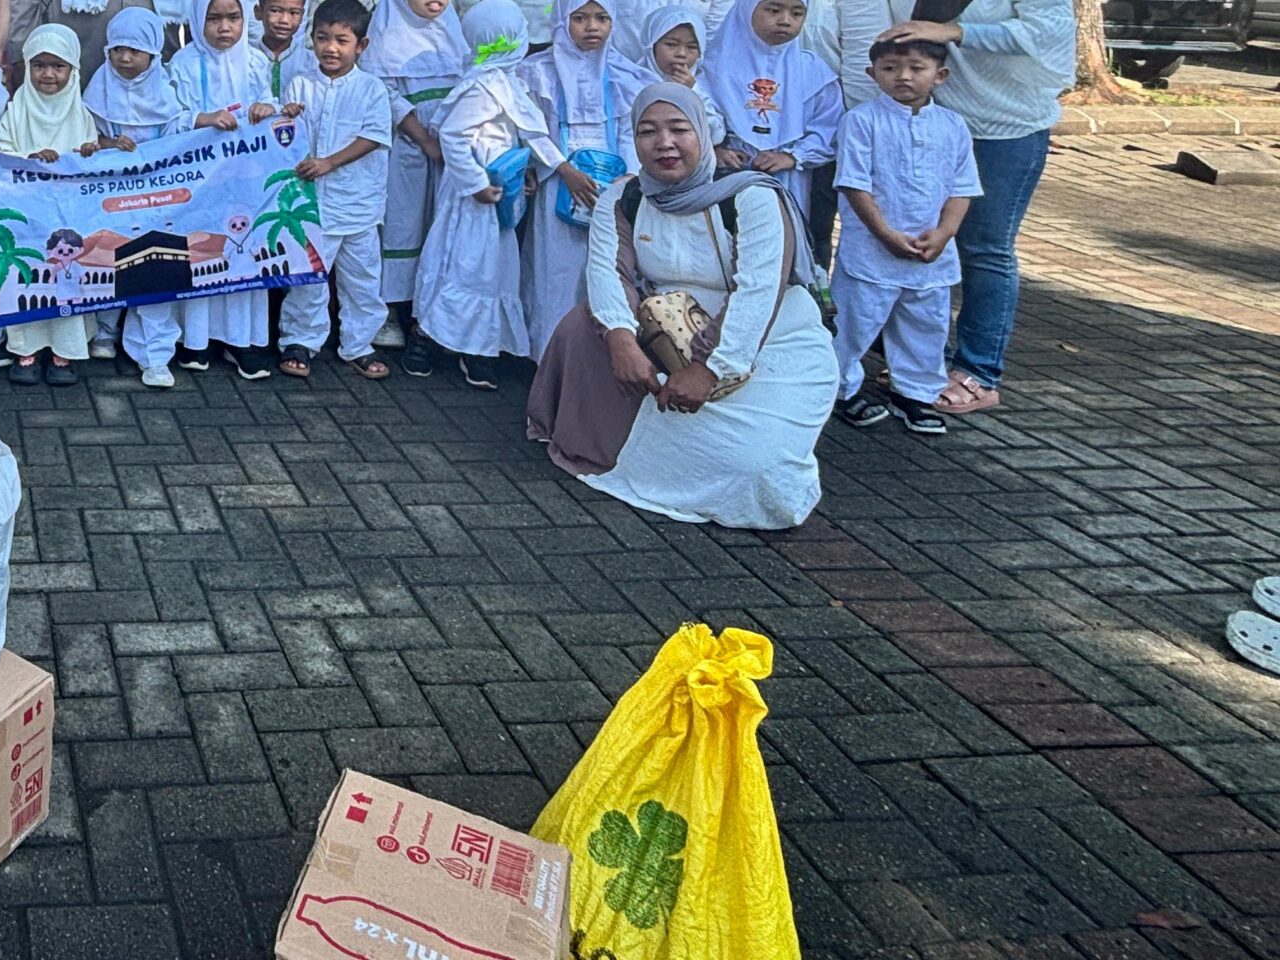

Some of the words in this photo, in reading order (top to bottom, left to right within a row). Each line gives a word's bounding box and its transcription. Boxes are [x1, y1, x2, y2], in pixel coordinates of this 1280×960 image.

[122, 145, 216, 177] MANASIK
[222, 135, 268, 158] HAJI
[80, 180, 105, 196] SPS
[109, 176, 146, 193] PAUD
[149, 169, 205, 188] KEJORA
[118, 197, 148, 208] Jakarta
[149, 194, 173, 204] Pusat
[451, 824, 494, 865] SNI
